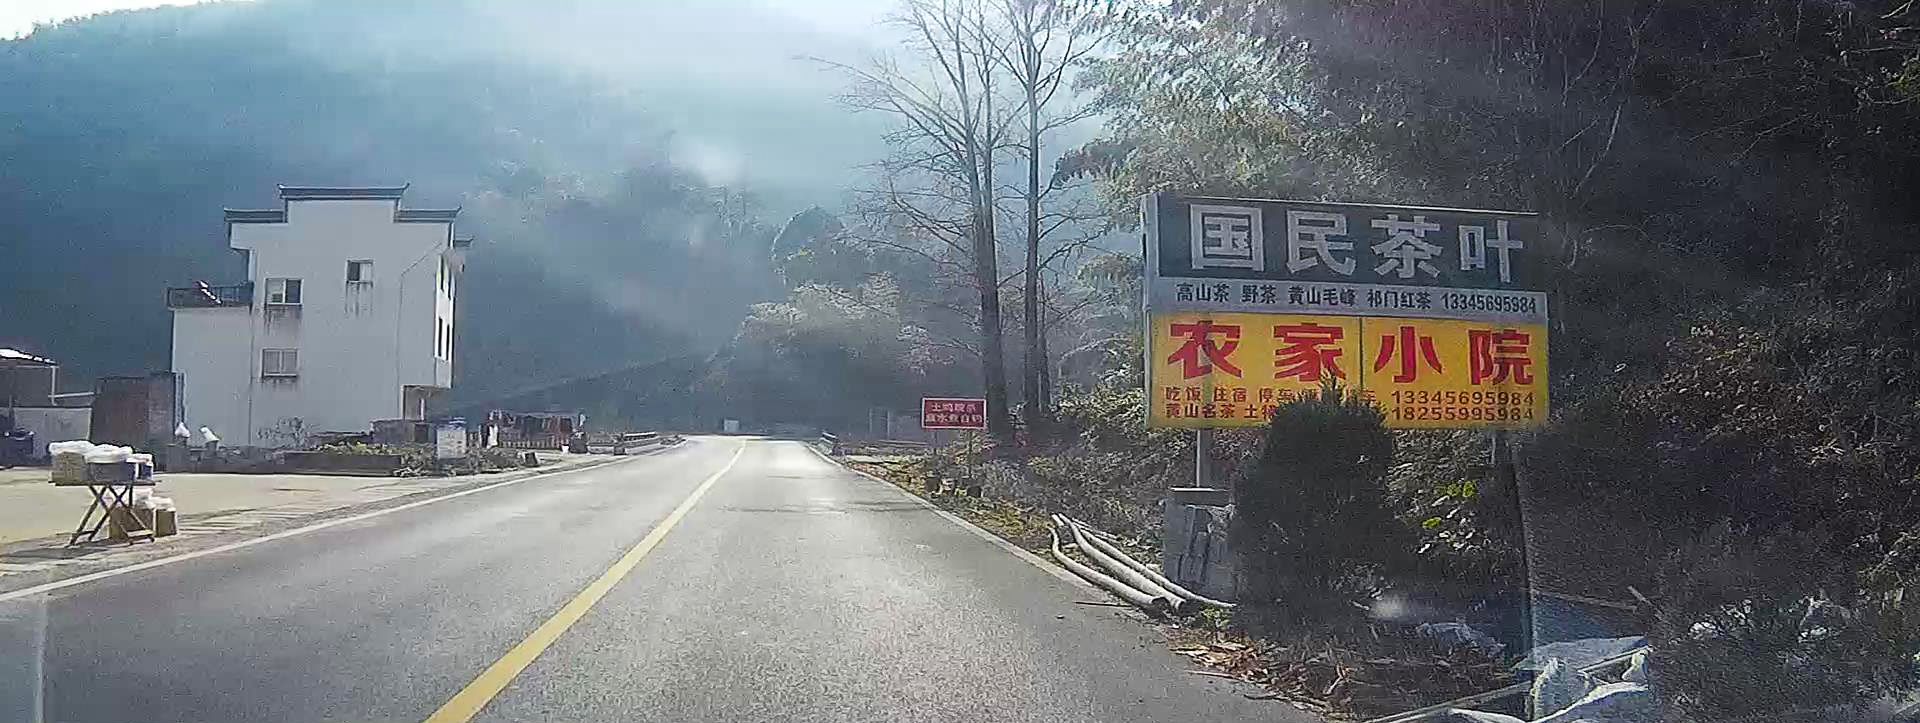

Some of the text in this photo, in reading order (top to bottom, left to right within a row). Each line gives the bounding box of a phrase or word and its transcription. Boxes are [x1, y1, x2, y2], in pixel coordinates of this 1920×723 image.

[1190, 204, 1523, 283] 国民茶叶
[1176, 283, 1537, 314] 高山茶 野茶 黄山毛峰 祁门红茶 13345695984
[1167, 320, 1533, 385] 农家小院
[1165, 386, 1201, 402] 吃饭
[1213, 386, 1248, 403] 住宿
[1391, 390, 1536, 405] 13345695984
[1165, 402, 1235, 419] 黄山名茶
[1391, 406, 1534, 421] 18255995984
